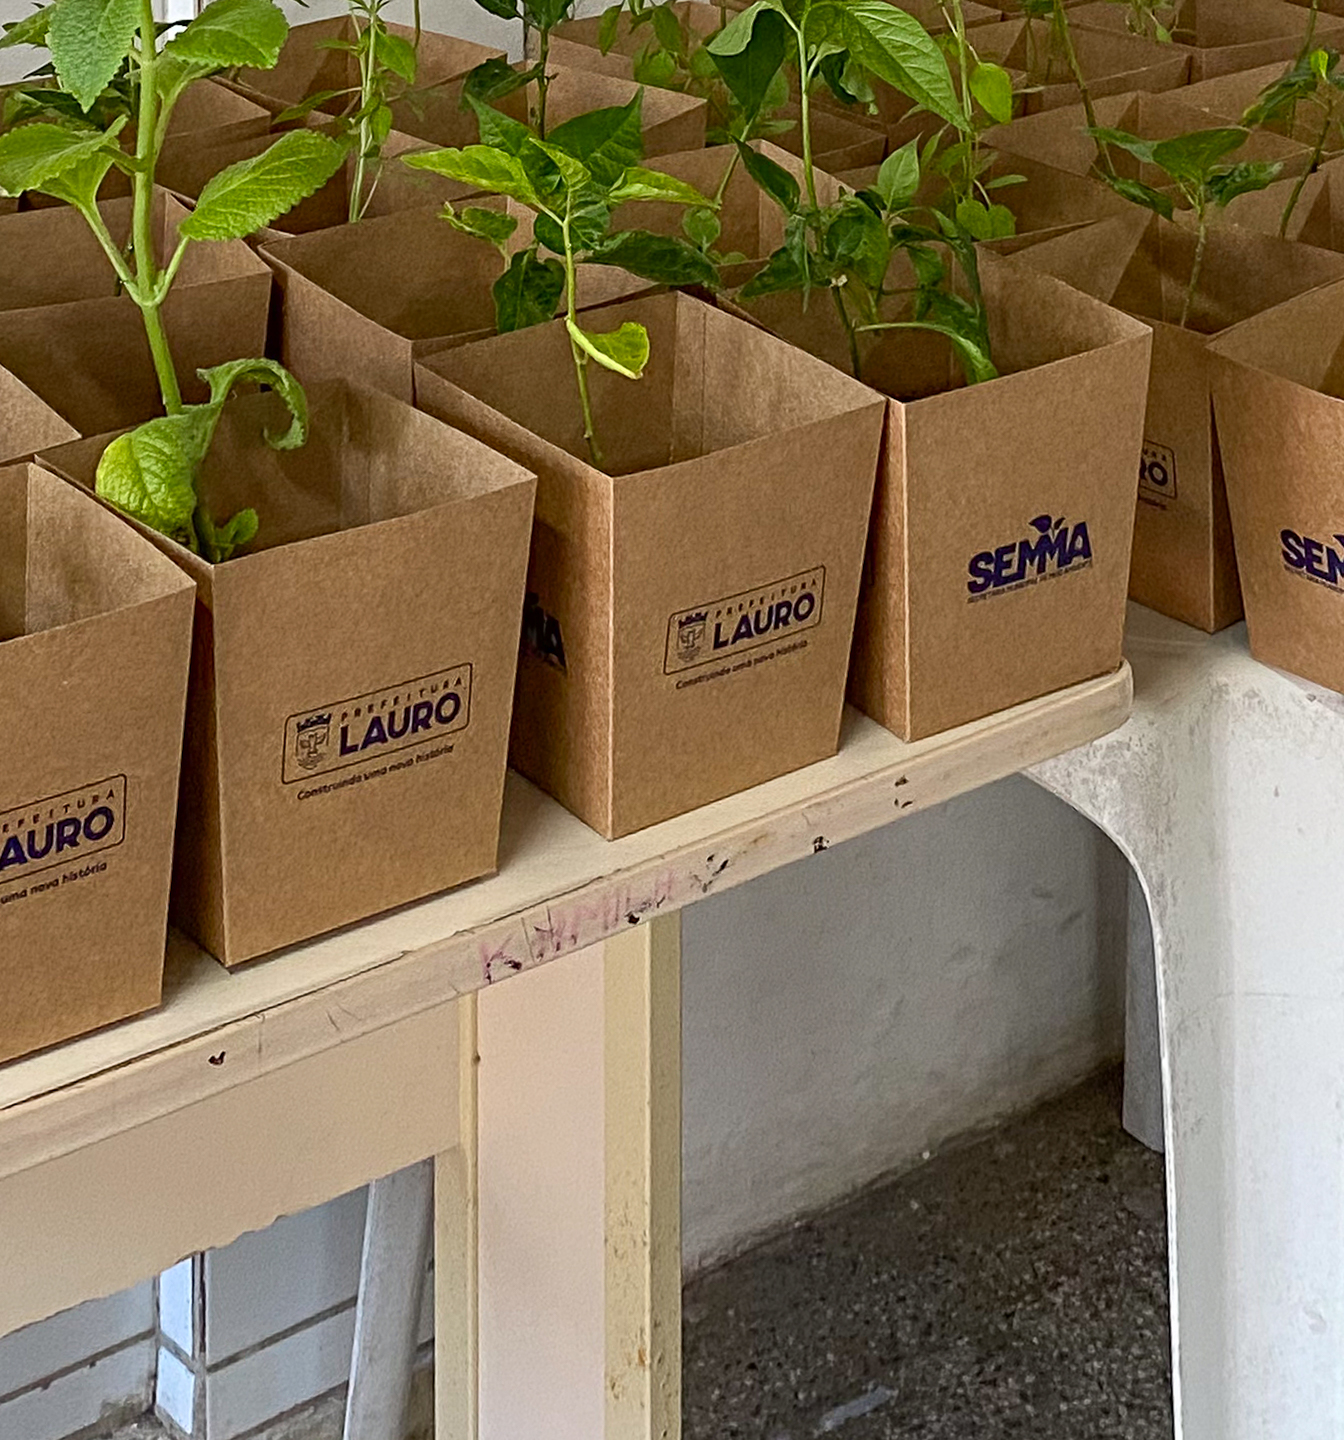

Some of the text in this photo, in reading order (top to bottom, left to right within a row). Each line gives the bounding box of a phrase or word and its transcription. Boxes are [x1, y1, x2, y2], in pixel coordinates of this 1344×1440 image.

[967, 520, 1093, 595] SEMMA
[713, 592, 816, 650] LAURO
[716, 578, 818, 616] PREFEITURA
[339, 692, 462, 757] LAURO
[340, 677, 463, 721] PREFEITURA
[0, 887, 28, 904] uma
[30, 878, 60, 895] nova
[61, 860, 108, 885] história
